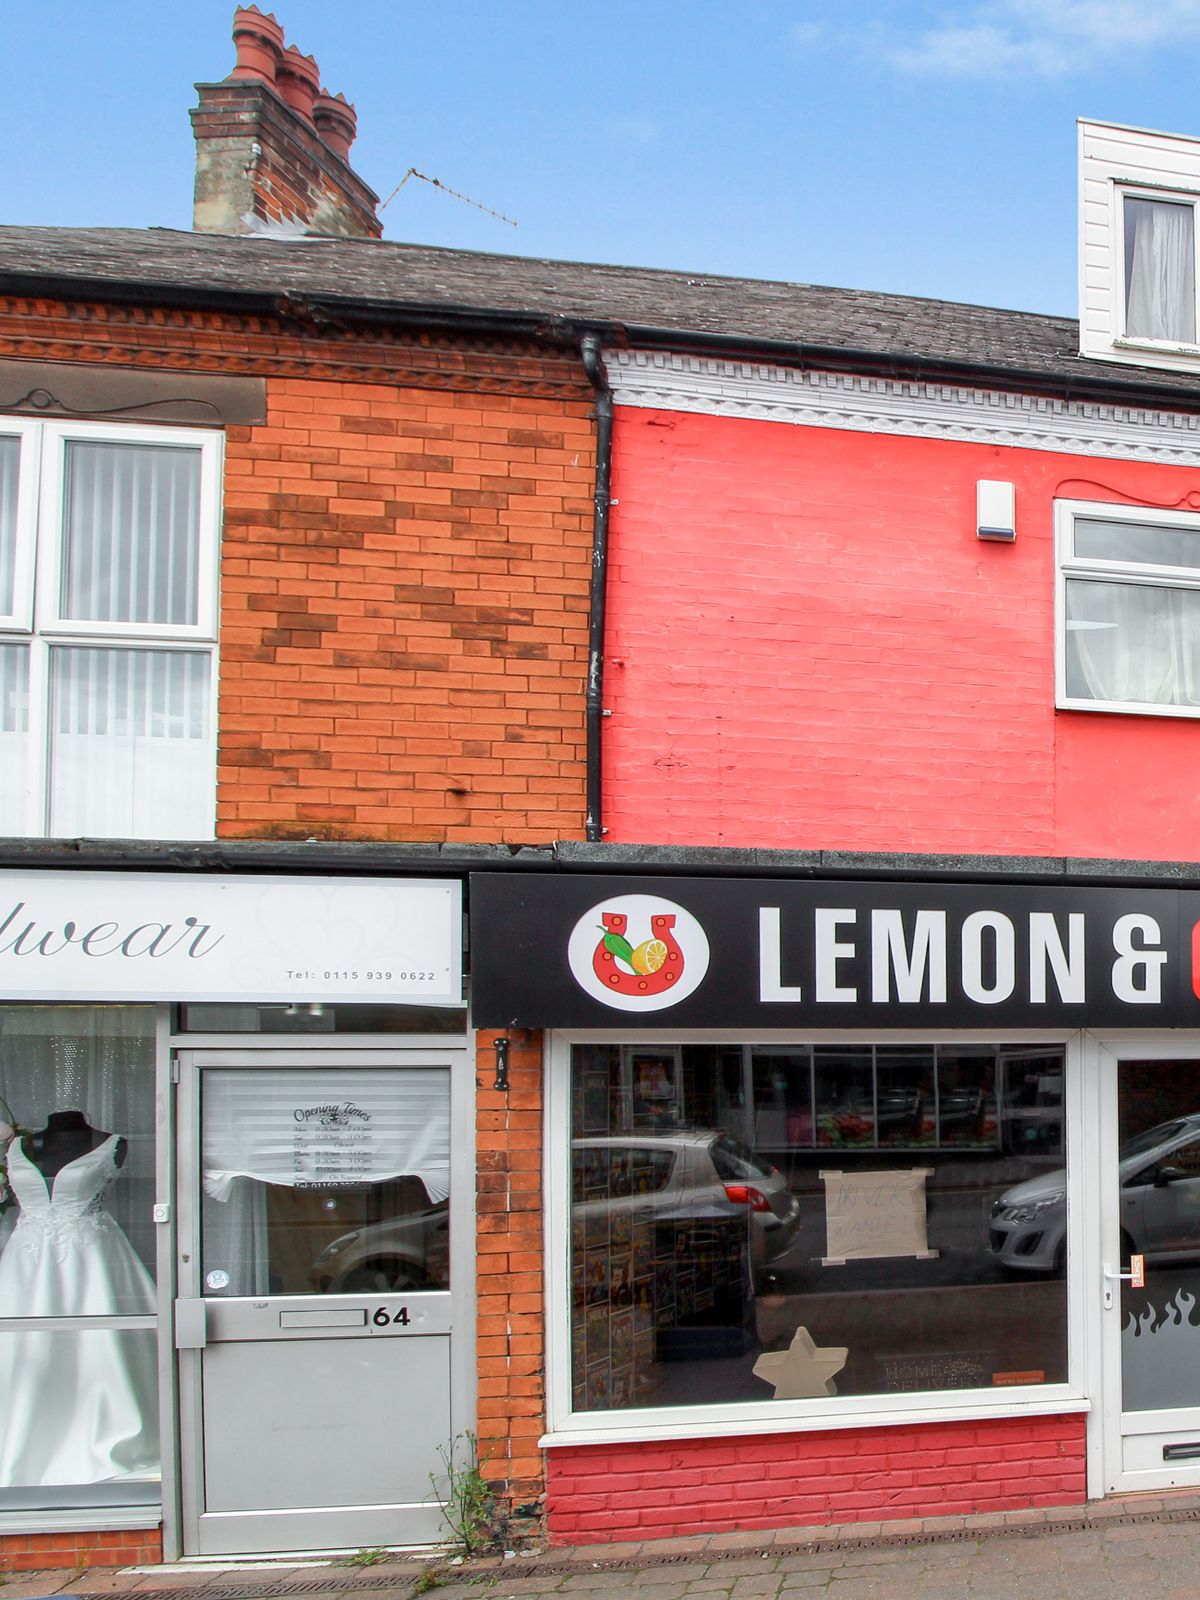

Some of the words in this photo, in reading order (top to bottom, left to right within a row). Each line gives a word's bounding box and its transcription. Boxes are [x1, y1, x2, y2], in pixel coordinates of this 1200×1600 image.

[759, 906, 1086, 1005] LEMON
[1111, 912, 1168, 1004] &
[286, 970, 315, 979] Tel:
[324, 971, 359, 980] 0115
[366, 971, 393, 980] 939
[400, 972, 435, 981] 0622
[294, 1103, 340, 1122] Opening
[343, 1101, 372, 1122] Times
[373, 1306, 411, 1327] 64
